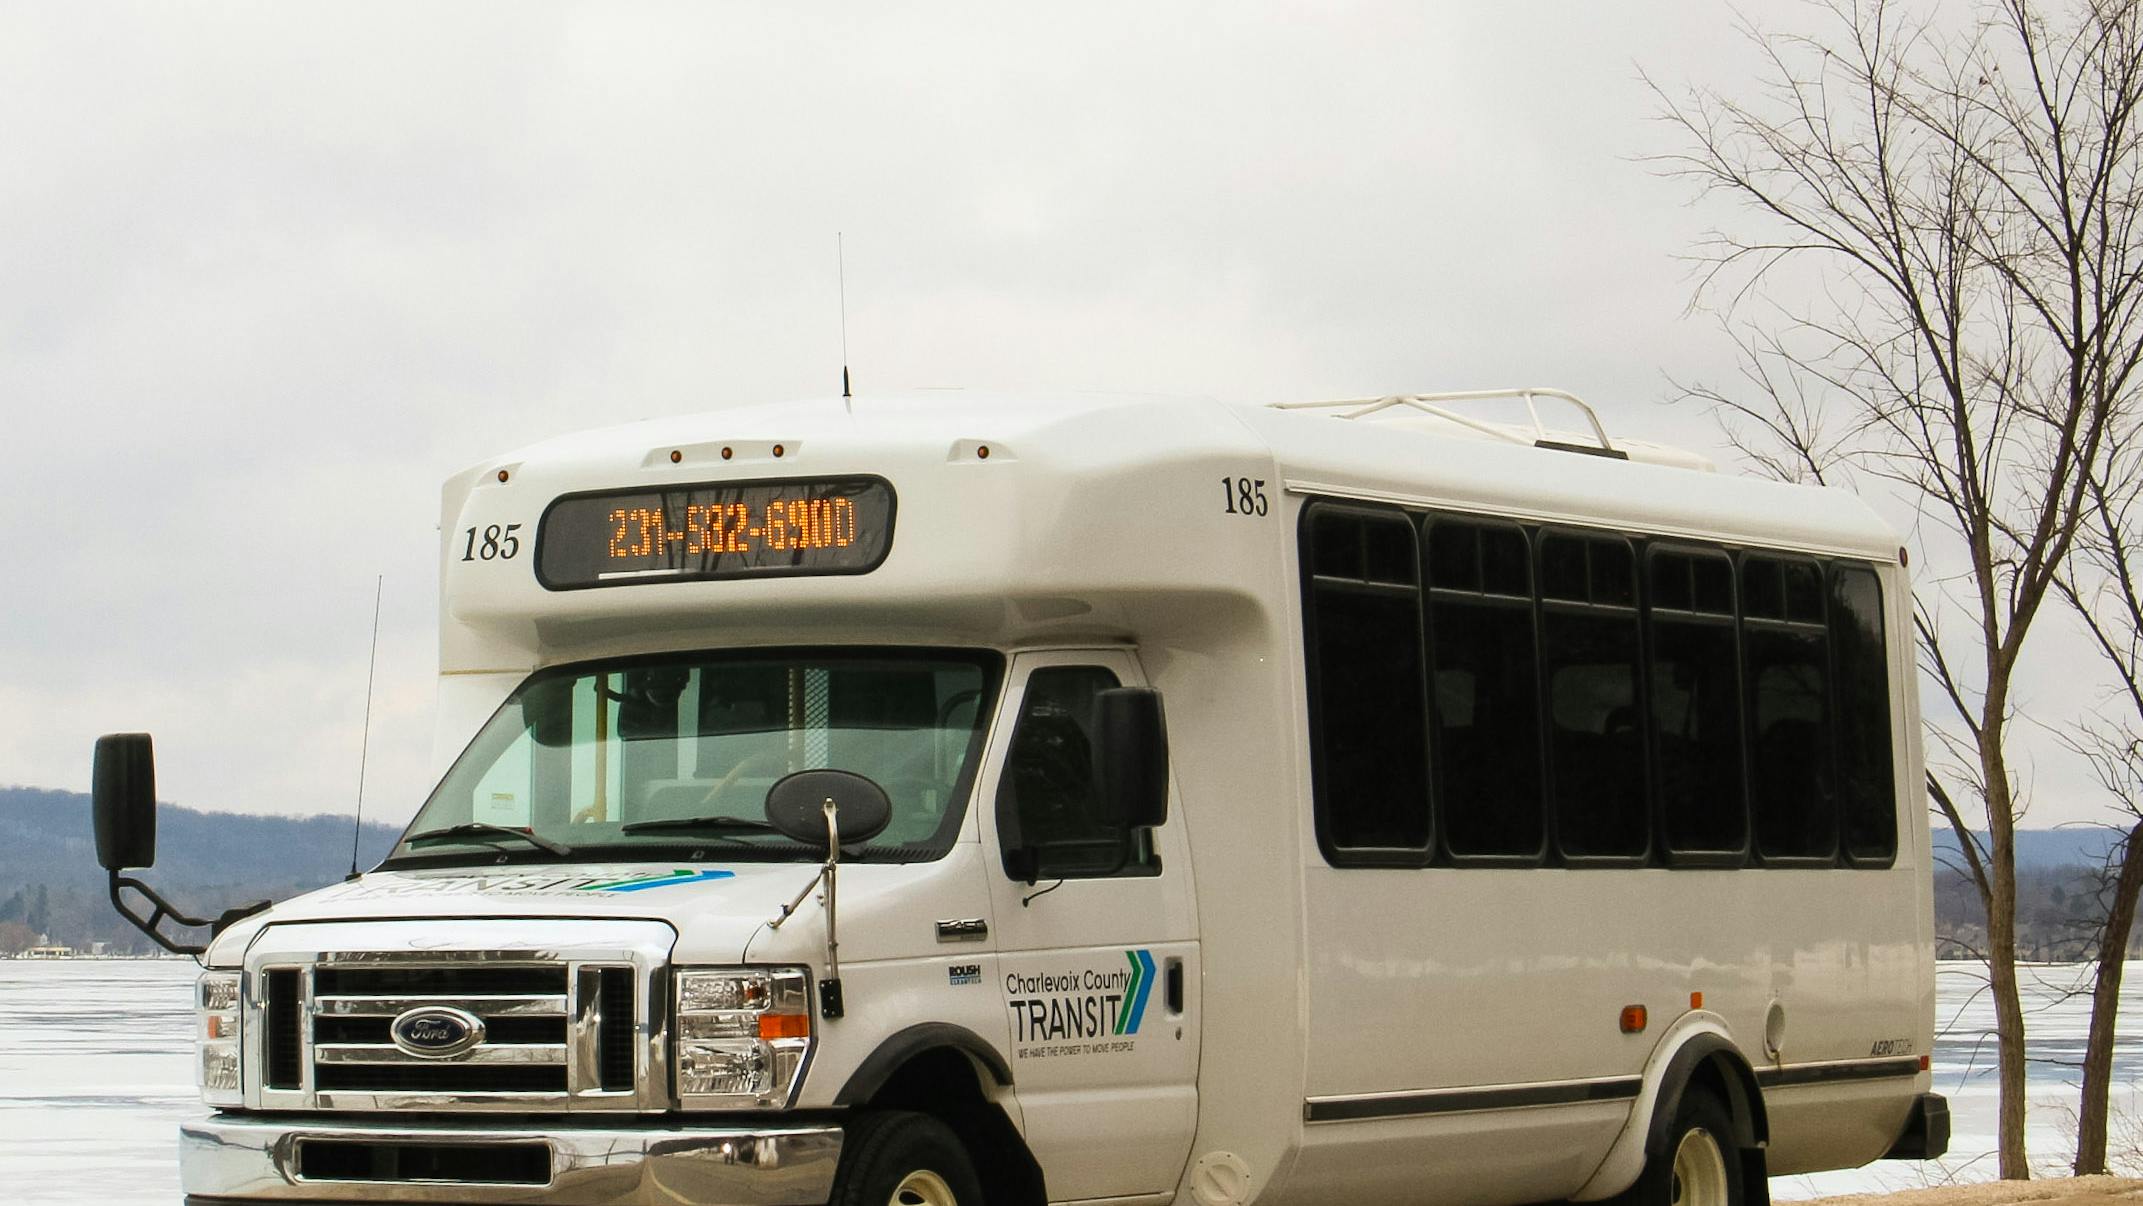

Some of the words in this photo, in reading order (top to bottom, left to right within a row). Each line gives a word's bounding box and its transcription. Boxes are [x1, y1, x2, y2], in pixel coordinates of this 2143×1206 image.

[1222, 477, 1268, 517] 185
[461, 523, 522, 562] 185
[949, 965, 981, 977] ROUSH
[1006, 971, 1080, 995] Charlevoix
[1084, 969, 1132, 992] County
[411, 1019, 450, 1039] Ford
[1009, 995, 1122, 1042] TRANSIT
[1018, 1048, 1028, 1059] WE
[1029, 1047, 1046, 1058] HAVE
[1047, 1046, 1058, 1057] THE
[1060, 1045, 1081, 1056] POWER
[1083, 1044, 1091, 1055] TO
[1092, 1042, 1109, 1054] MOVE
[1111, 1041, 1135, 1053] PEOPLE
